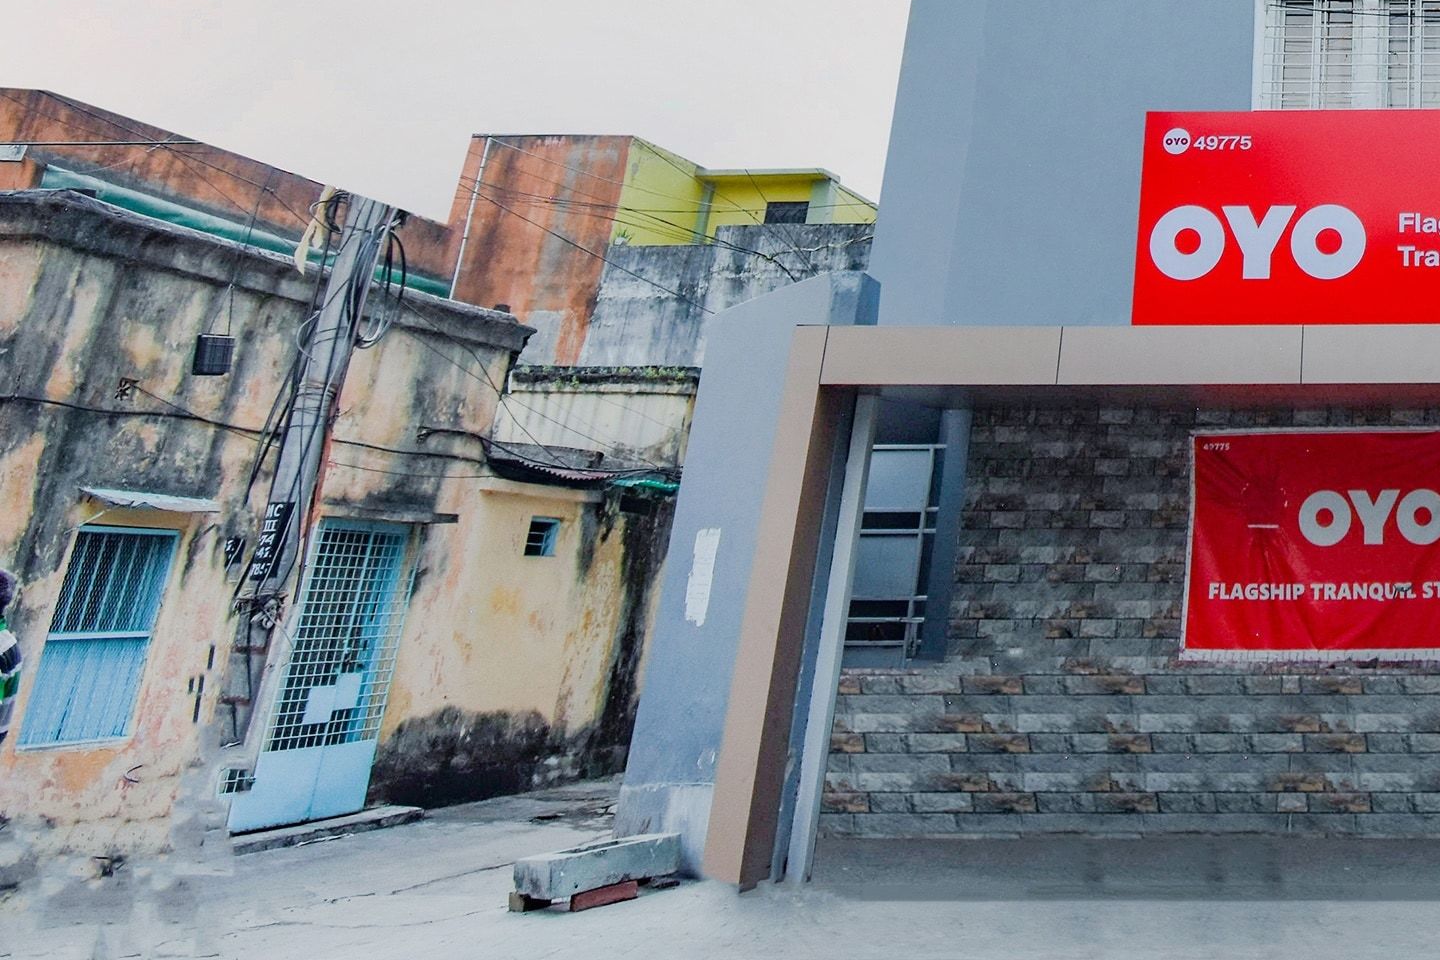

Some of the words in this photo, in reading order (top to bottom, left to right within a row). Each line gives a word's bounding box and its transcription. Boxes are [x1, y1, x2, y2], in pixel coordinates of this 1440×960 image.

[1165, 137, 1188, 146] OYO
[1193, 135, 1252, 151] 49775
[1149, 204, 1367, 281] OYO
[1208, 582, 1305, 601] FLAGSHIP
